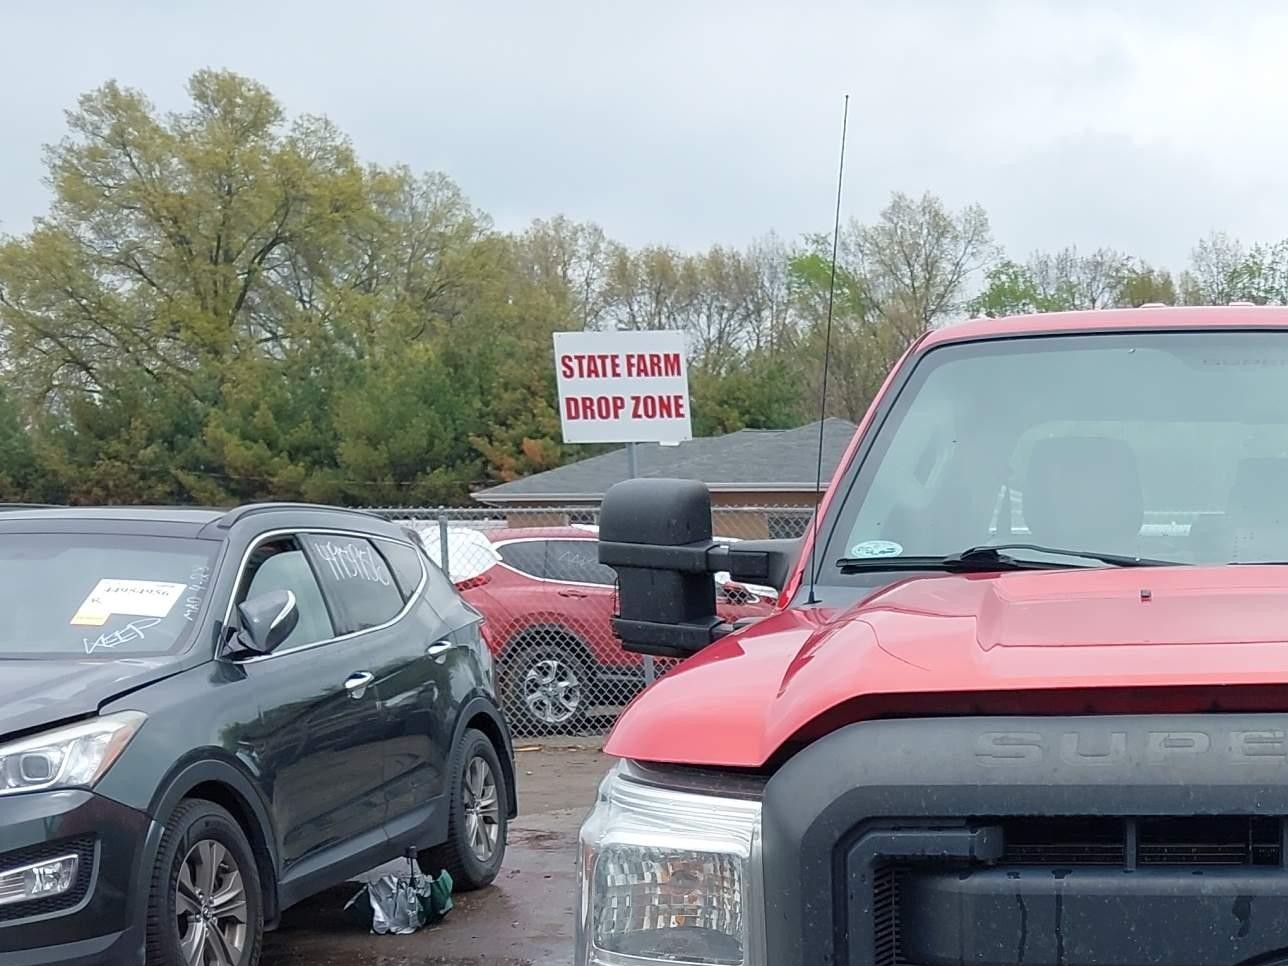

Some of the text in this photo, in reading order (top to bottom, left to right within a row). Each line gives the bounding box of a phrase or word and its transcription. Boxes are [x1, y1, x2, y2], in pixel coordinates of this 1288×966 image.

[561, 353, 682, 379] STATE FARM
[564, 395, 686, 421] DROP ZONE
[83, 617, 162, 655] KEEP
